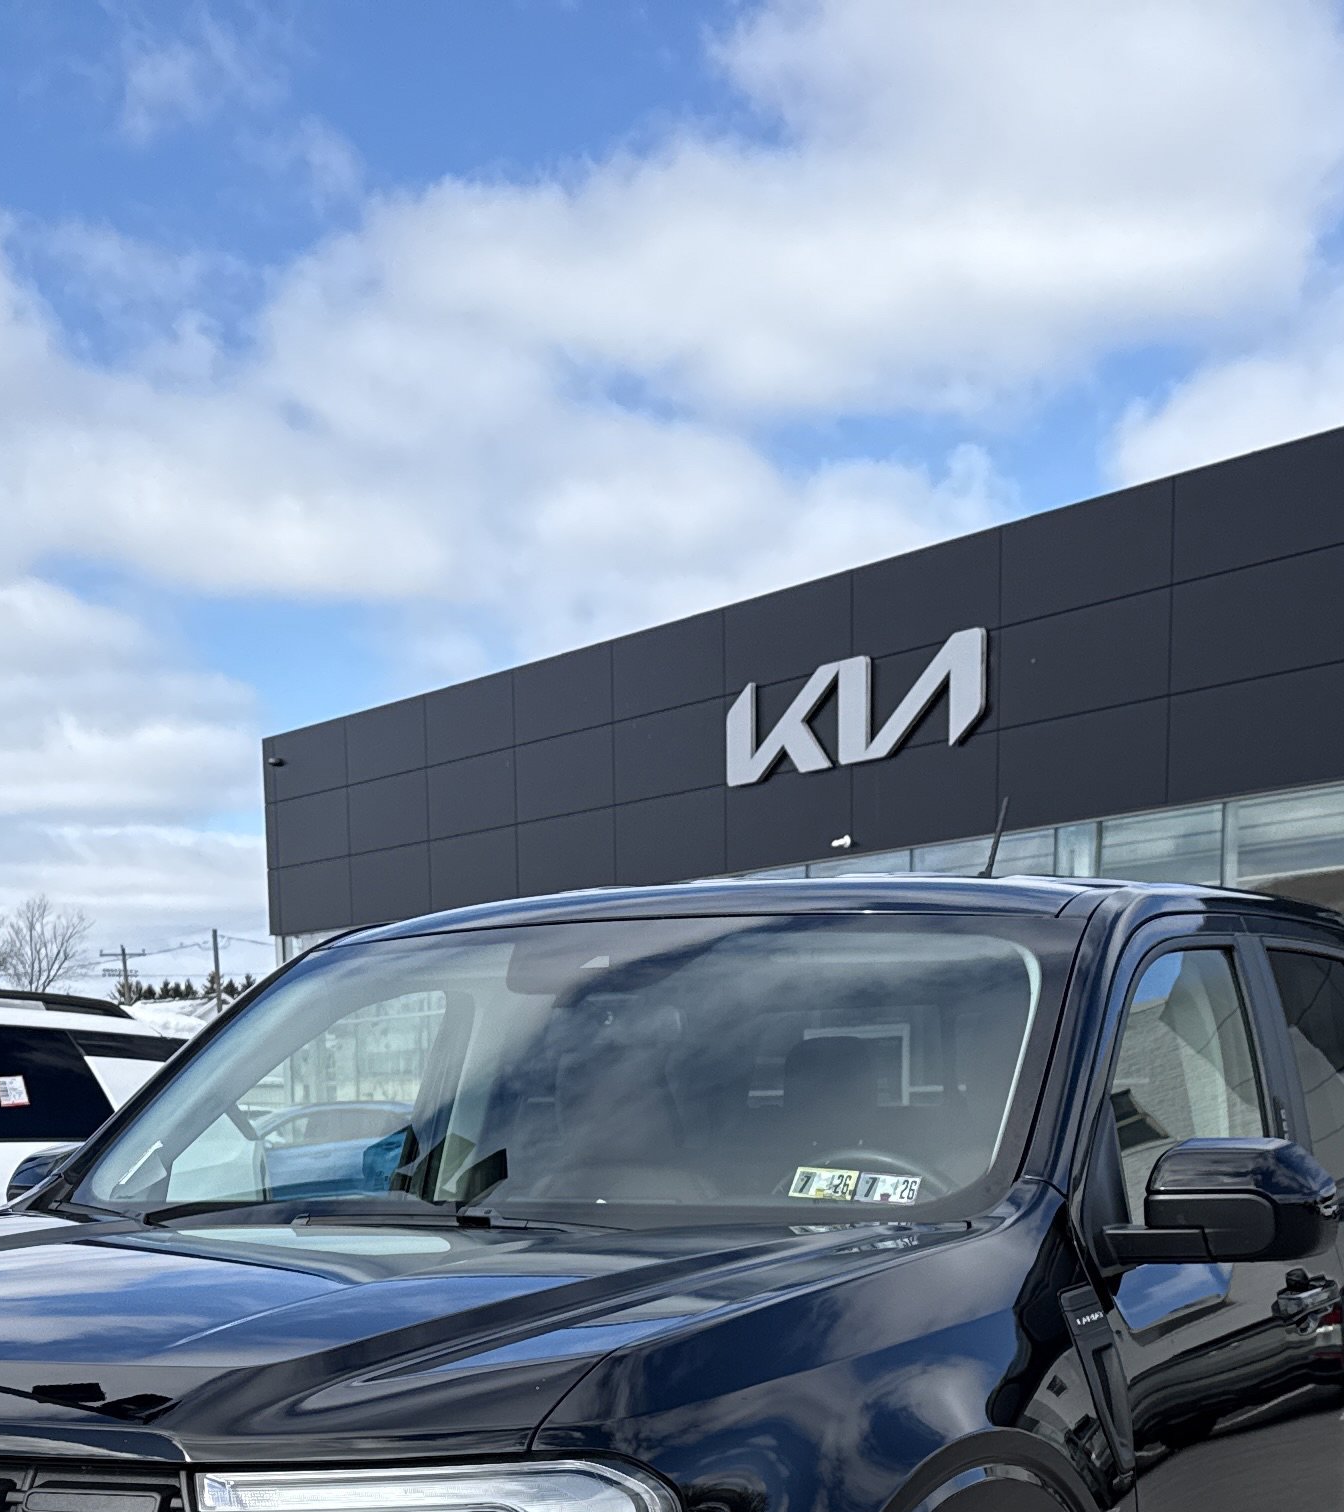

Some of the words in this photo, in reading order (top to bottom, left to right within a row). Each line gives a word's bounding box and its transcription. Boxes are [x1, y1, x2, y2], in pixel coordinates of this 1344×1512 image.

[726, 627, 987, 787] KIA
[798, 1176, 811, 1194] 7
[833, 1175, 852, 1195] 26
[864, 1177, 877, 1197] 7
[899, 1180, 917, 1200] 26
